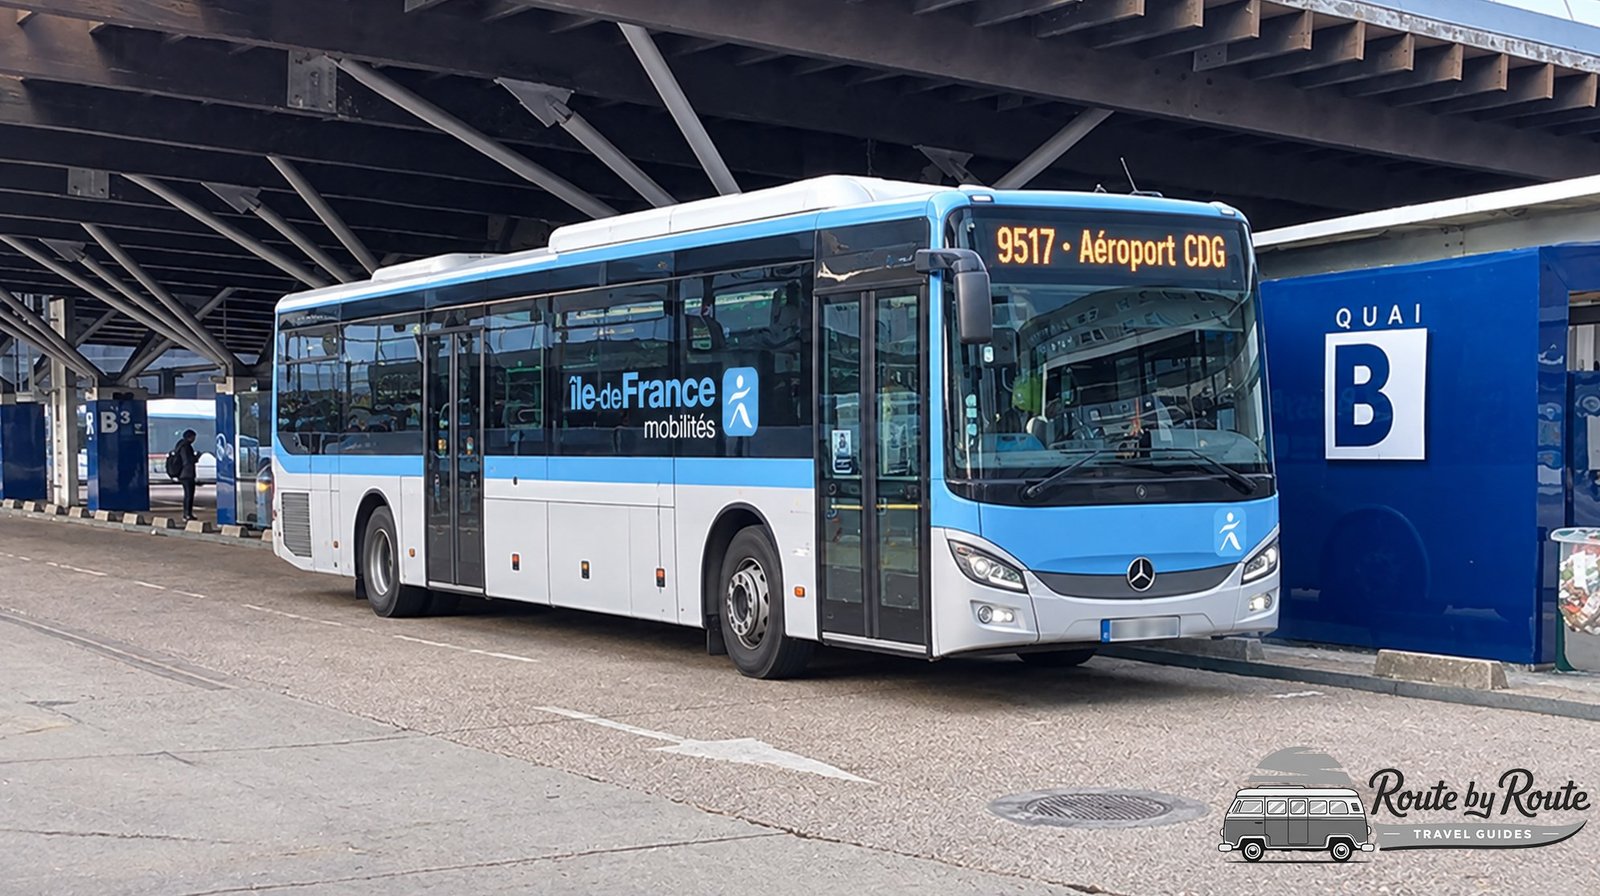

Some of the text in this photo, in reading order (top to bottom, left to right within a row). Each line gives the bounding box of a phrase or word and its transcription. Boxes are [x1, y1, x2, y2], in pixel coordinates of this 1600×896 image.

[996, 226, 1055, 265] 9517
[1079, 229, 1176, 272] Aéroport
[1184, 234, 1226, 268] CDG
[1335, 303, 1421, 330] QUAI
[1335, 343, 1394, 448] B
[643, 413, 716, 439] mobilités
